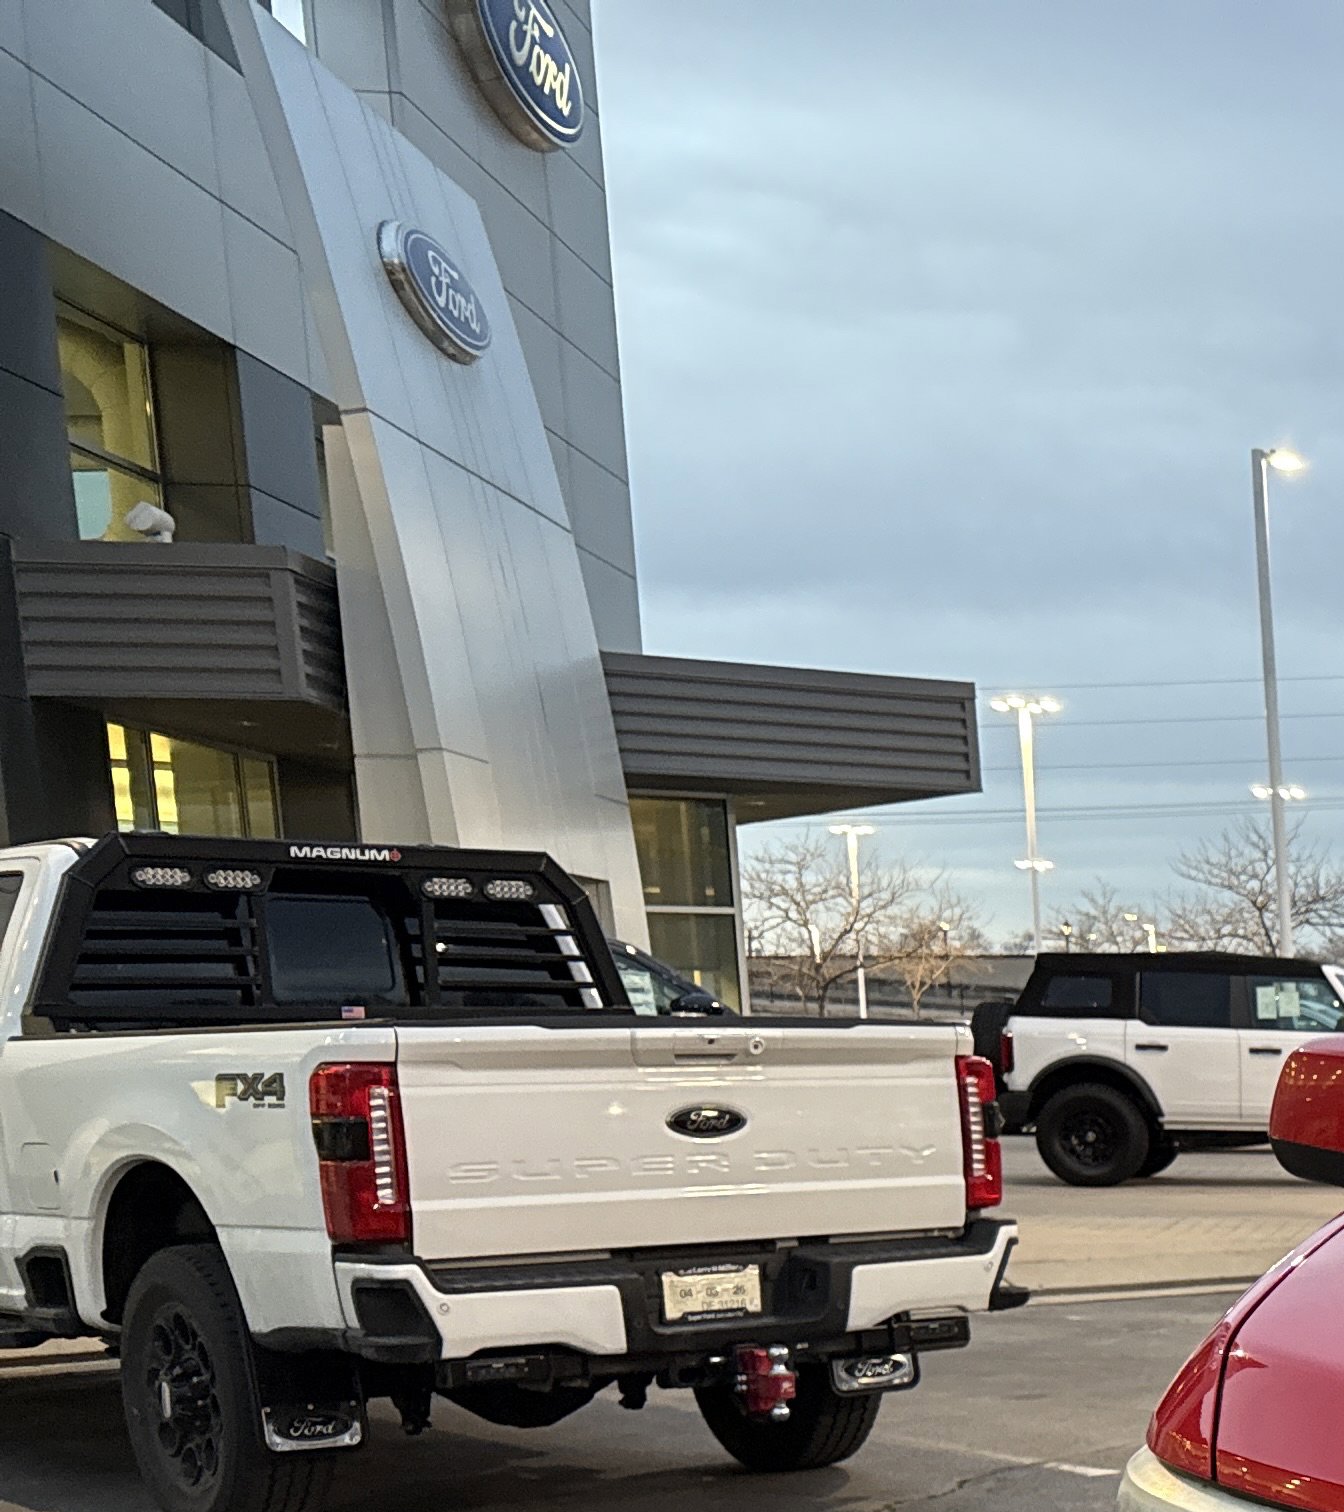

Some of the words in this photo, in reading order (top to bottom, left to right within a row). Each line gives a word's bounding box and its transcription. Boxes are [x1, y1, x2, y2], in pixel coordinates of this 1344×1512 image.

[509, 0, 572, 117] Ford
[427, 250, 481, 334] Ford
[289, 845, 391, 861] MAGNUM
[215, 1072, 285, 1108] FX4
[686, 1110, 730, 1130] Ford
[447, 1150, 731, 1186] SUPER
[752, 1143, 938, 1172] DUTY
[854, 1358, 895, 1377] Ford
[289, 1417, 337, 1437] Ford
